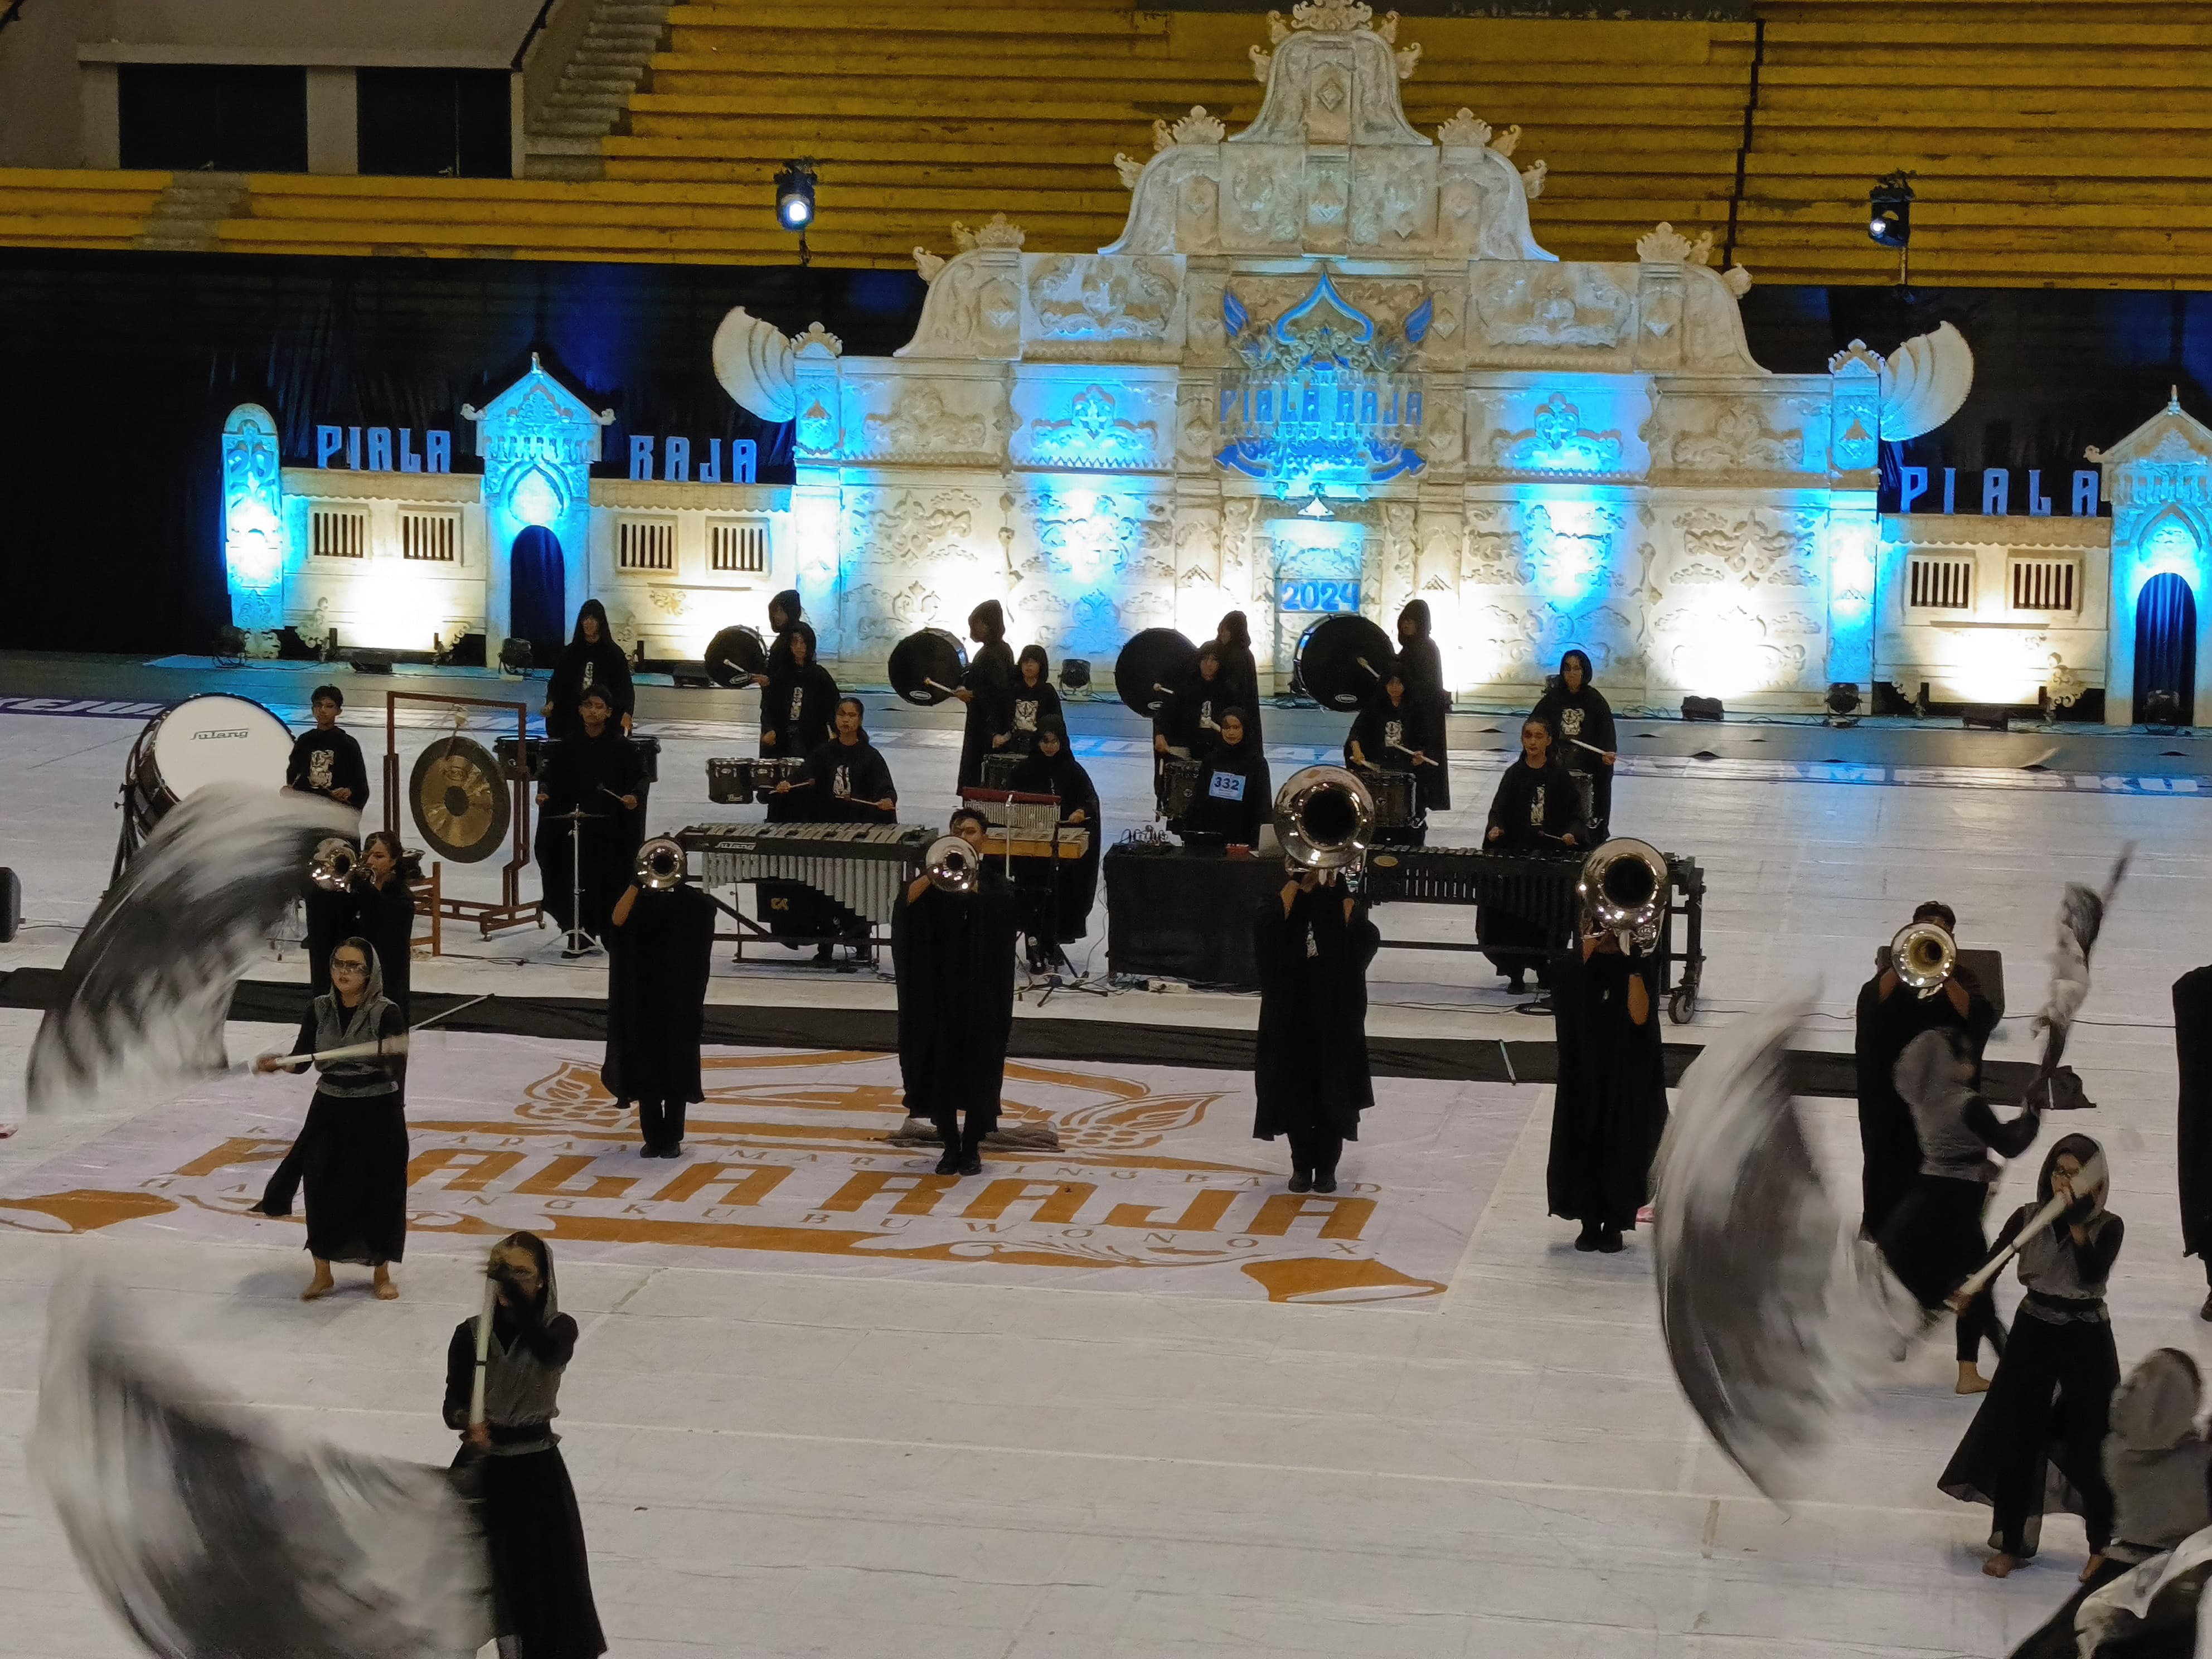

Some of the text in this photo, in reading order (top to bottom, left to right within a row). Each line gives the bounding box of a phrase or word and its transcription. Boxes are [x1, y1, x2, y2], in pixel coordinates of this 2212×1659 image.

[1220, 389, 1423, 424] PIALA RAJA
[316, 424, 451, 474] PIALA
[629, 434, 756, 484] RAJA
[1899, 466, 2099, 517] PIALA
[1282, 583, 1359, 612] 2024
[1213, 776, 1240, 791] 332
[173, 1136, 1379, 1241] PALA RAJA
[728, 1148, 1138, 1180] MARCING
[1184, 1173, 1383, 1194] BAD
